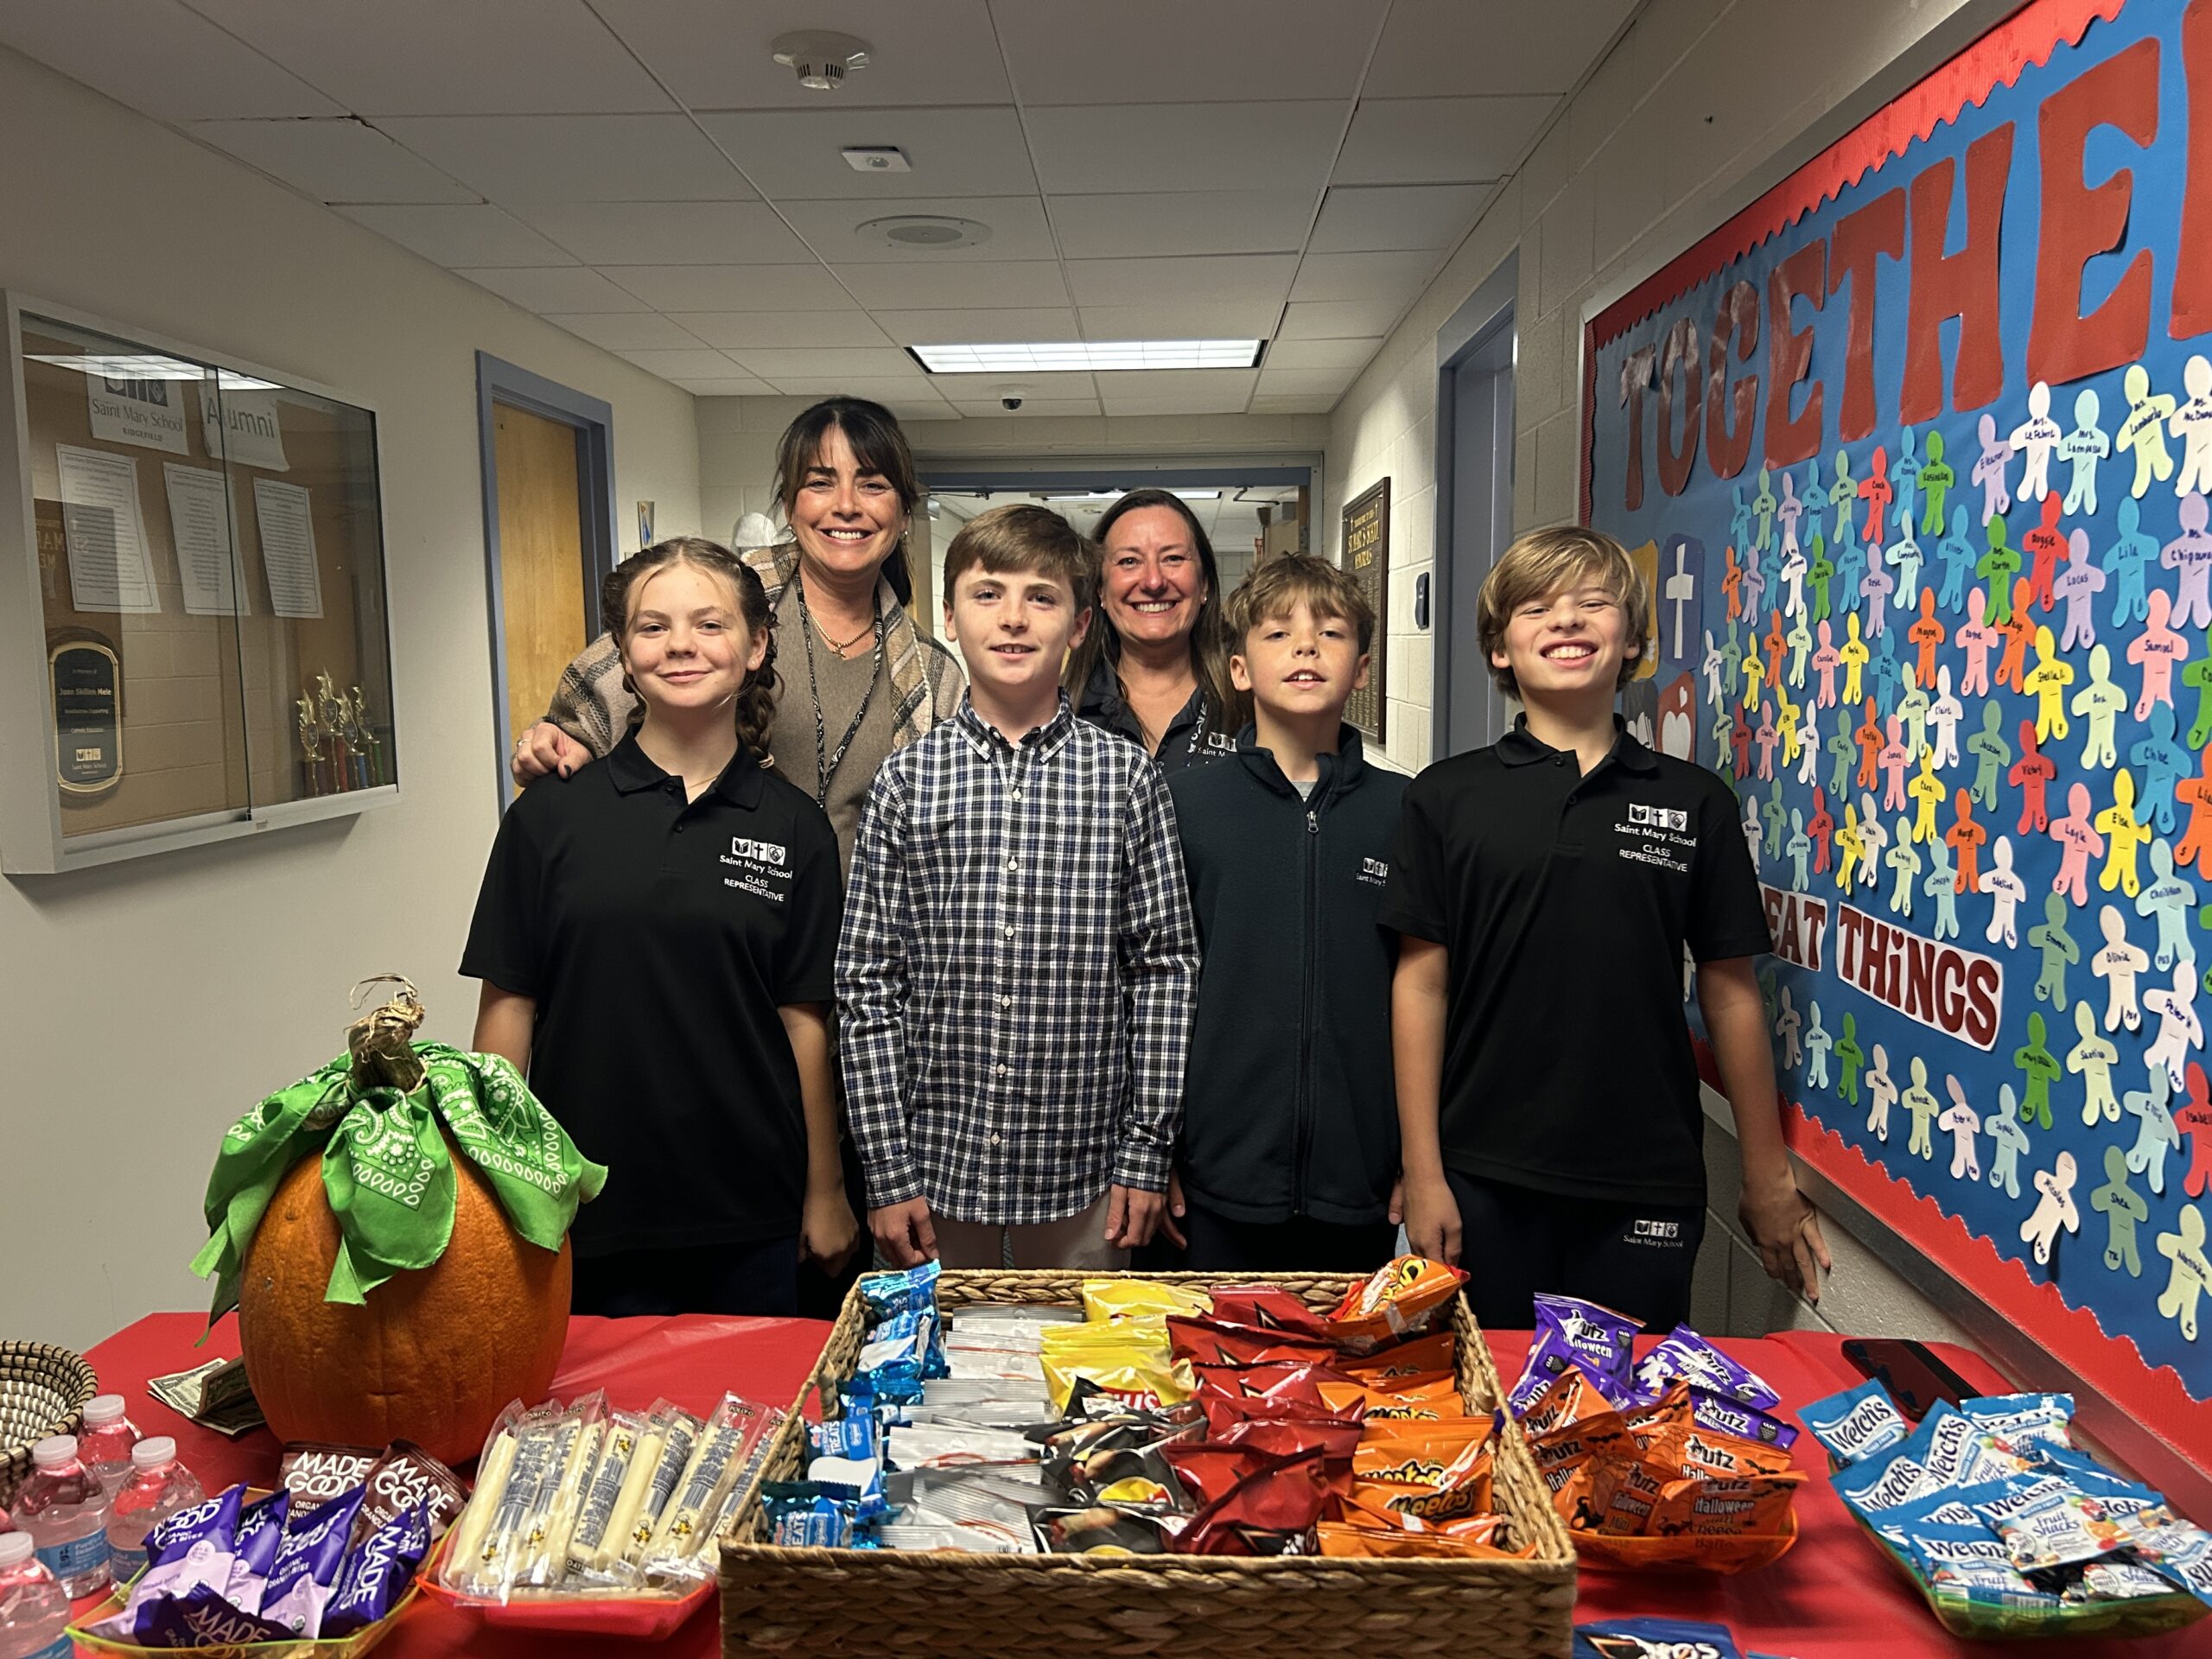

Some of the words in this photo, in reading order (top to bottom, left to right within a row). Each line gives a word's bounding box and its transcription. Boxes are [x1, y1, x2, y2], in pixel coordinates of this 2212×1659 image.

[92, 398, 121, 418] Saint
[124, 406, 149, 427] Mary
[150, 412, 183, 432] School
[122, 427, 163, 442] RIDGEFIELD
[2144, 639, 2174, 653] Samuel
[1614, 823, 1641, 836] Saint
[1642, 828, 1667, 842] Mary
[1669, 832, 1697, 848] School
[1619, 849, 1688, 872] REPRESENTATIVE
[1643, 844, 1671, 857] CLASS
[720, 855, 742, 867] Saint
[744, 860, 766, 874] Mary
[767, 866, 792, 880] School
[724, 878, 785, 902] REPRESENTATIVE
[745, 874, 769, 888] CLASS
[1764, 887, 1826, 971] EAT
[1624, 1235, 1642, 1244] Saint
[1643, 1237, 1662, 1249] Mary
[1827, 1399, 1893, 1451] Welch's
[830, 1421, 843, 1455] TREATS
[292, 1451, 372, 1478] MADE
[284, 1471, 361, 1497] GOOD
[389, 1458, 454, 1518] MADE
[1610, 1490, 1652, 1517] Halloween
[1695, 1497, 1756, 1514] Halloween
[792, 1511, 809, 1547] EATS
[2032, 1519, 2081, 1539] Snacks
[2035, 1511, 2068, 1530] Fruit
[353, 1526, 402, 1605] MADE
[183, 1605, 271, 1643] MADE
